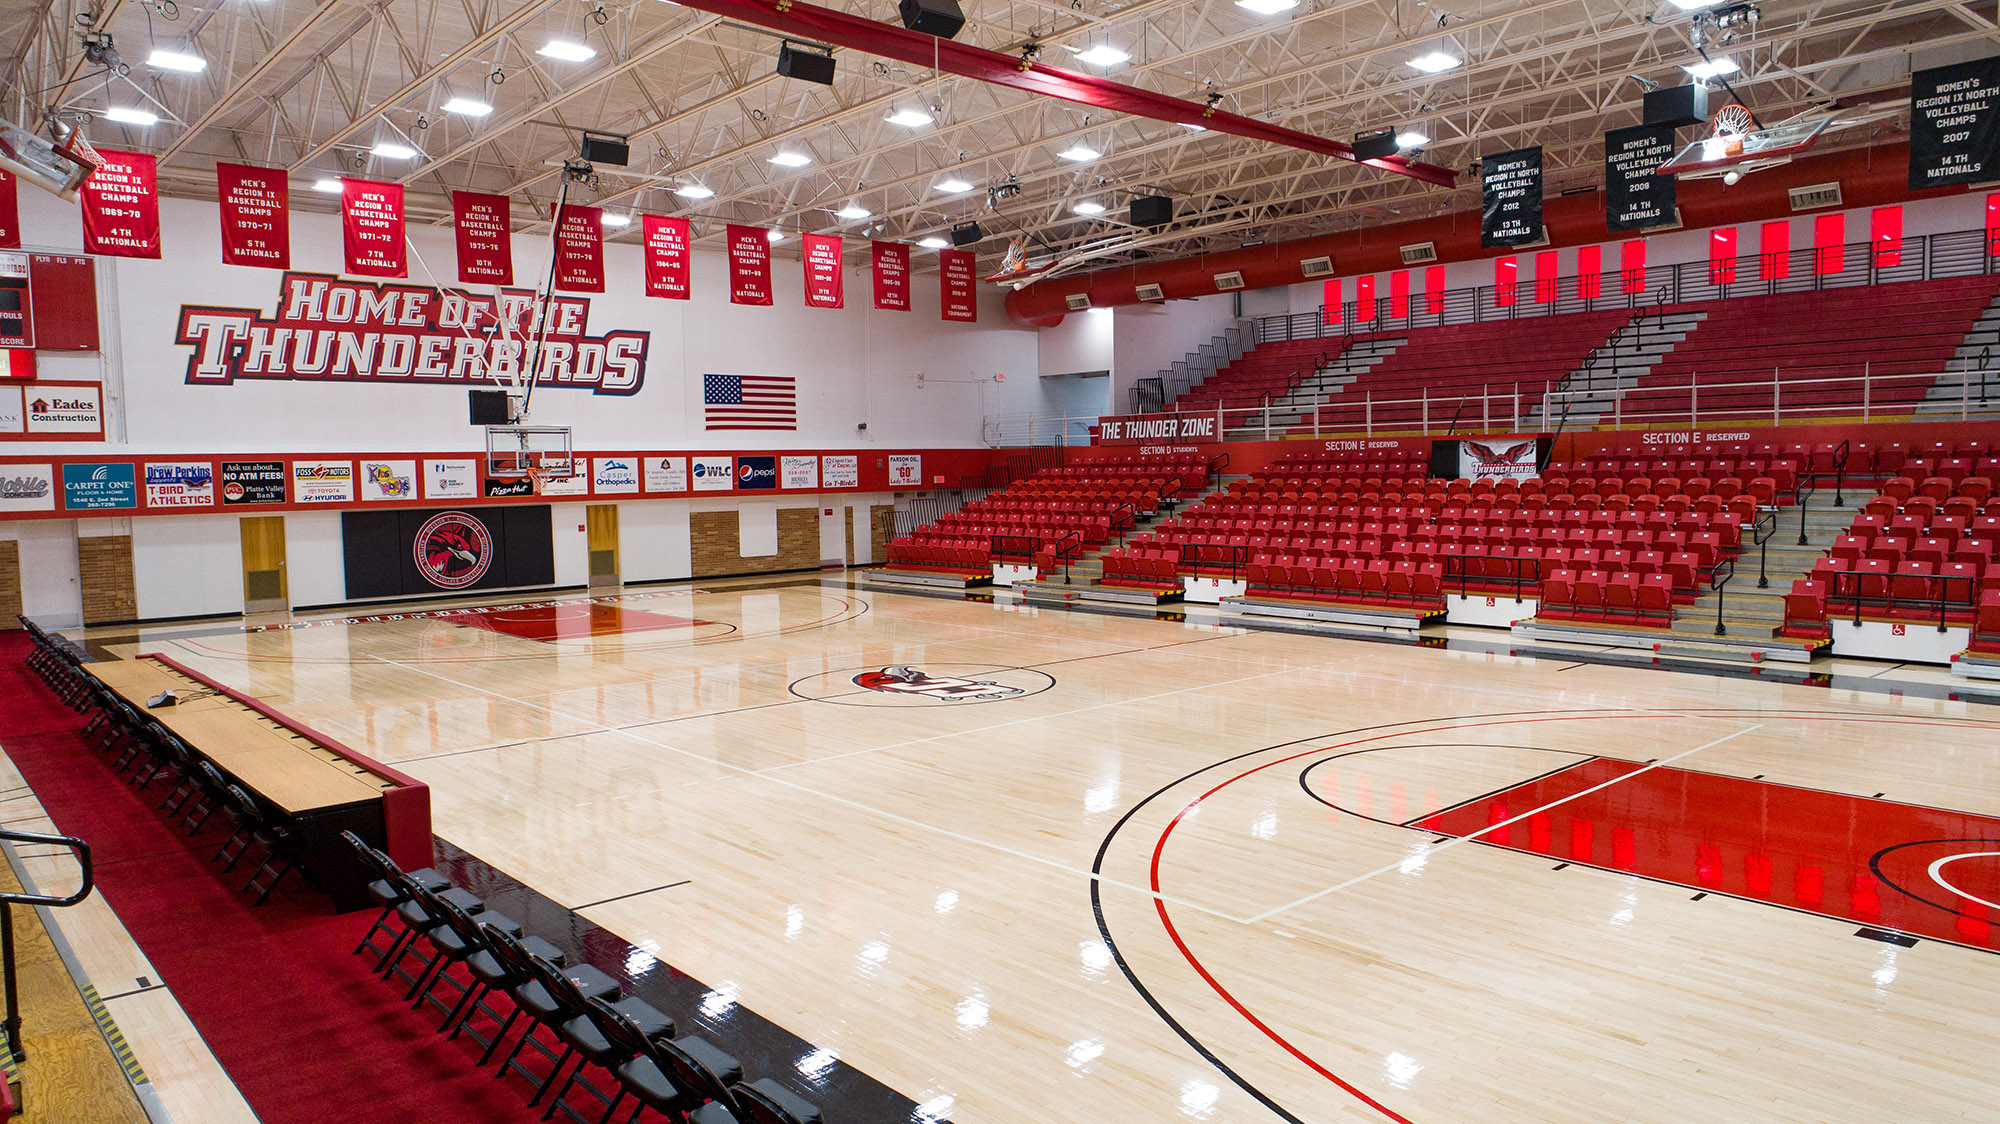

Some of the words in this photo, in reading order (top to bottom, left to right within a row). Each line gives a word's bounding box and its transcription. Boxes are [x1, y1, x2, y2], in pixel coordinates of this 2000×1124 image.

[1936, 78, 1980, 94] WOMEN'S
[1916, 95, 1950, 109] REGION
[1953, 93, 1963, 103] IX
[1966, 87, 2000, 101] NORTH
[1926, 101, 1990, 119] VOLLEYBALL
[1937, 114, 1977, 128] CHAMPS
[1943, 131, 1970, 144] 2007
[1623, 137, 1657, 150] WOMEN'S
[1608, 152, 1635, 163] REGION
[1637, 150, 1645, 159] IX
[1646, 144, 1672, 157] NORTH
[104, 164, 132, 174] MEN'S
[1498, 161, 1527, 172] WOMEN'S
[1616, 157, 1664, 171] VOLLEYBALL
[1486, 174, 1508, 184] REGION
[1509, 172, 1516, 180] IX
[1517, 167, 1539, 179] NORTH
[1625, 168, 1655, 180] CHAMPS
[1928, 163, 1981, 178] NATIONALS
[95, 173, 128, 183] REGION
[90, 182, 149, 195] BASKETBALL
[241, 179, 266, 189] MEN'S
[1491, 179, 1533, 191] VOLLEYBALL
[1629, 182, 1650, 192] 2008
[101, 193, 138, 203] CHAMPS
[233, 188, 263, 197] REGION
[267, 191, 275, 199] IX
[362, 193, 385, 202] MEN'S
[1498, 188, 1525, 199] CHAMPS
[228, 196, 282, 208] BASKETBALL
[355, 201, 382, 209] REGION
[385, 204, 393, 212] IX
[1503, 202, 1520, 212] 2012
[101, 208, 141, 218] 1969-70
[238, 207, 272, 216] CHAMPS
[472, 205, 492, 213] MEN'S
[350, 209, 398, 221] BASKETBALL
[466, 213, 490, 221] REGION
[1620, 209, 1661, 222] NATIONALS
[238, 221, 272, 231] 1970-71
[360, 219, 390, 228] CHAMPS
[461, 221, 504, 231] BASKETBALL
[470, 230, 497, 238] CHAMPS
[563, 225, 585, 233] REGION
[1493, 226, 1530, 238] NATIONALS
[359, 232, 392, 242] 1971-72
[653, 234, 673, 242] REGION
[98, 237, 148, 248] NATIONALS
[566, 240, 591, 248] CHAMPS
[650, 241, 685, 250] BASKETBALL
[235, 248, 280, 258] NATIONALS
[356, 258, 397, 268] NATIONALS
[468, 267, 504, 275] NATIONALS
[564, 276, 598, 284] NATIONALS
[654, 283, 685, 291] NATIONALS
[287, 280, 428, 327] HOME
[437, 295, 488, 331] OF
[502, 294, 584, 335] THE
[189, 315, 645, 390] THUNDERBIRDS
[52, 399, 94, 410] Eades
[32, 414, 97, 422] Construction
[1101, 422, 1122, 440] THE
[1125, 419, 1178, 439] THUNDER
[1181, 417, 1215, 437] ZONE
[1642, 432, 1690, 445] SECTION
[1692, 432, 1701, 444] E
[1706, 432, 1750, 443] RESERVED
[1140, 446, 1166, 455] SECTION
[1167, 446, 1172, 455] D
[1173, 446, 1198, 454] STUDENTS
[1325, 441, 1359, 451] SECTION
[1360, 441, 1366, 451] E
[1368, 441, 1399, 449] RESERVED
[147, 467, 173, 478] Drew
[175, 466, 211, 478] Perkins
[297, 468, 312, 476] FOSS
[707, 466, 731, 477] WLC
[754, 468, 775, 478] pepsi
[896, 466, 915, 478] "GO"
[1473, 462, 1534, 474] THUNDERBIRDS
[224, 473, 237, 481] NO
[239, 472, 258, 480] ATM
[260, 472, 284, 480] FEES!
[66, 482, 106, 490] CARPET
[596, 478, 636, 487] Orthopedics
[149, 486, 184, 495] T-BIRD
[491, 486, 512, 496] Pizza
[150, 496, 212, 505] ATHLETICS
